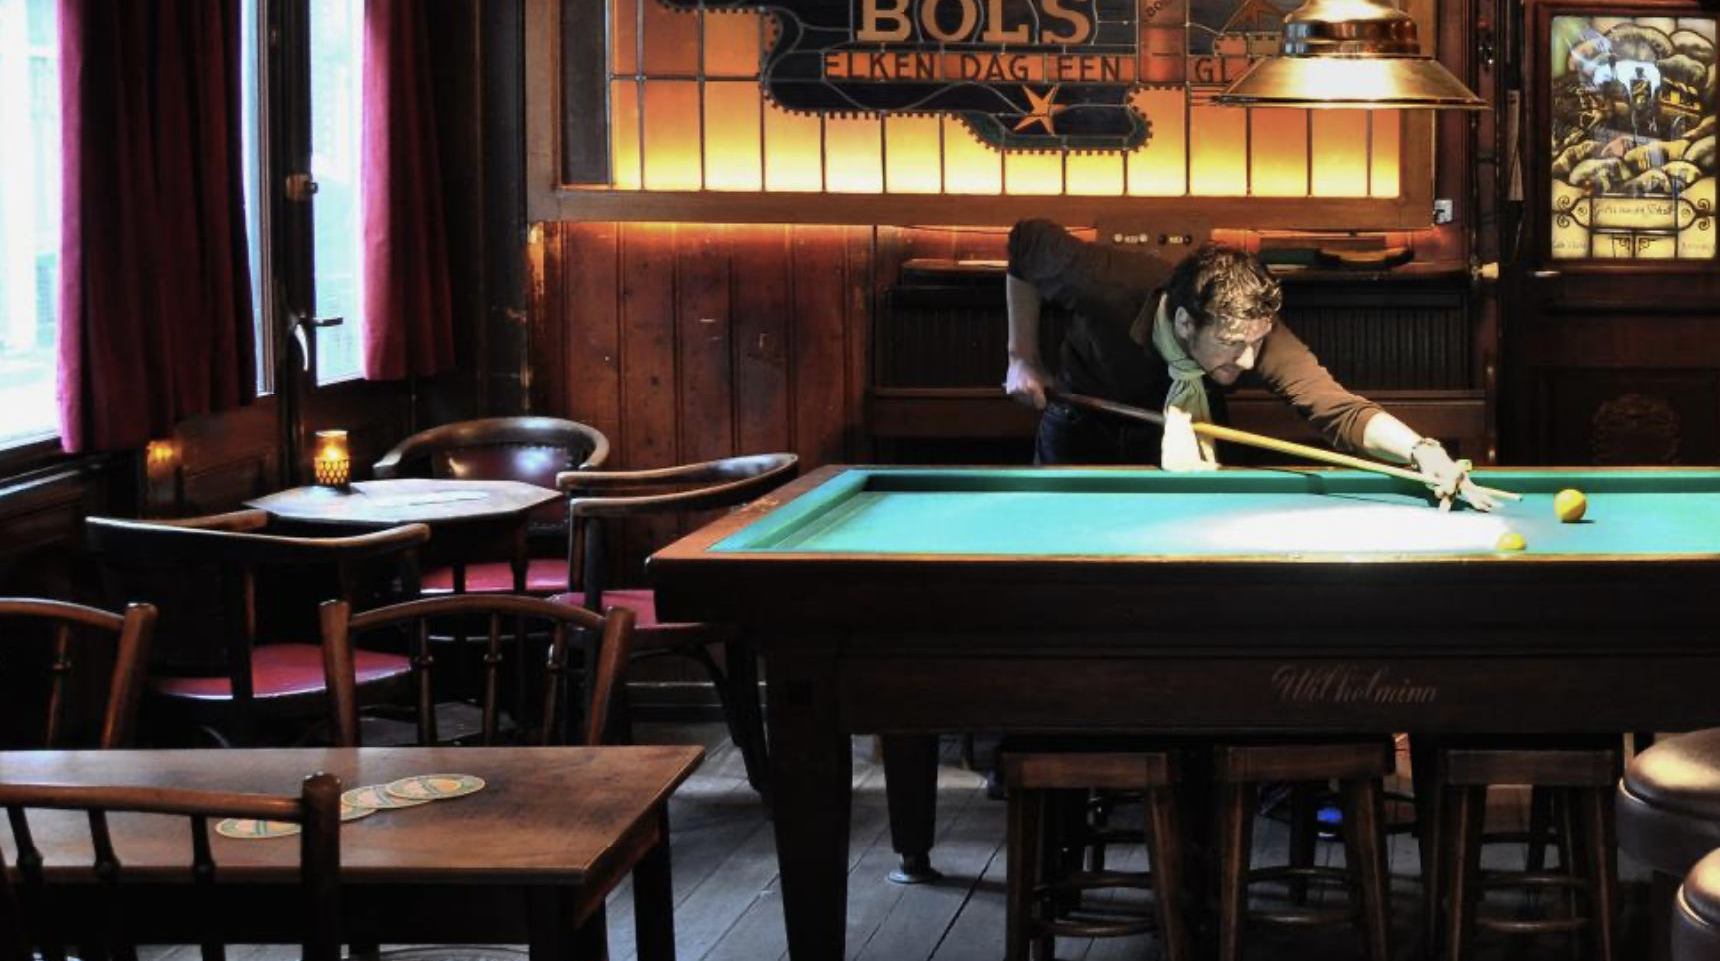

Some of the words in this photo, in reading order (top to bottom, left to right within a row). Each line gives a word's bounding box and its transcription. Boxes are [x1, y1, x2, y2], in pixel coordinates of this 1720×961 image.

[823, 52, 936, 82] ELKEN
[958, 53, 1030, 82] DAG
[1057, 55, 1122, 83] EEN
[1194, 56, 1237, 83] GL
[1271, 662, 1440, 704] Wilhelmina
